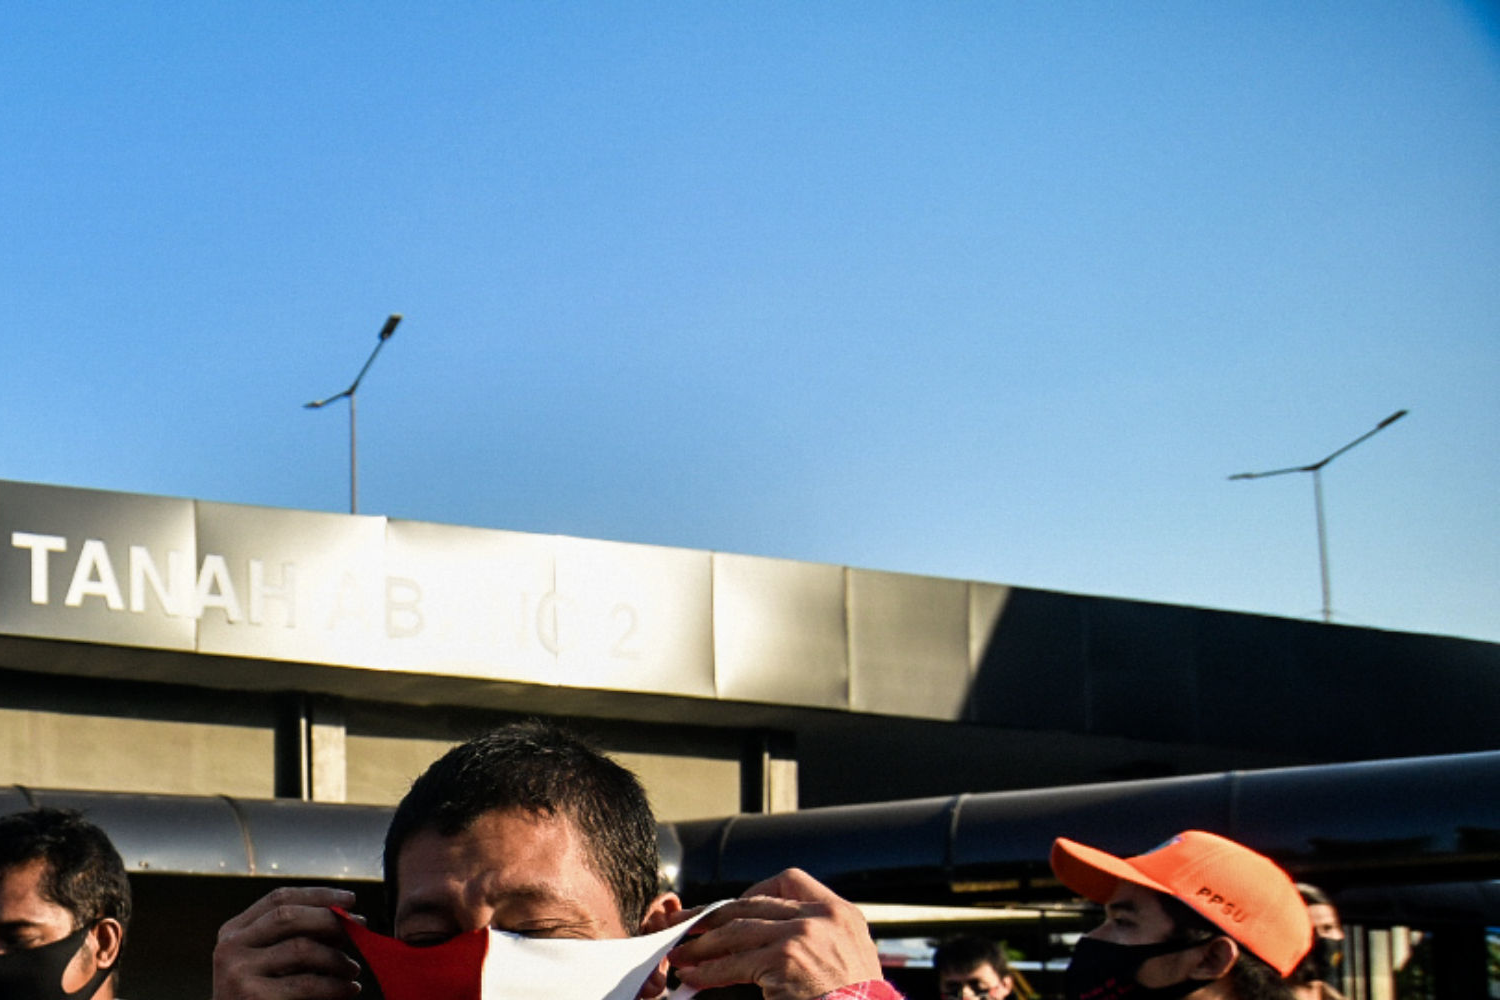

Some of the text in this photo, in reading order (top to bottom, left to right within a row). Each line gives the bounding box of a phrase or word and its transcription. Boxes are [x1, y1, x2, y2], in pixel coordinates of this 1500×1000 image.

[11, 531, 297, 629] TANAH
[608, 601, 641, 661] 2
[1196, 886, 1248, 923] PPSU
